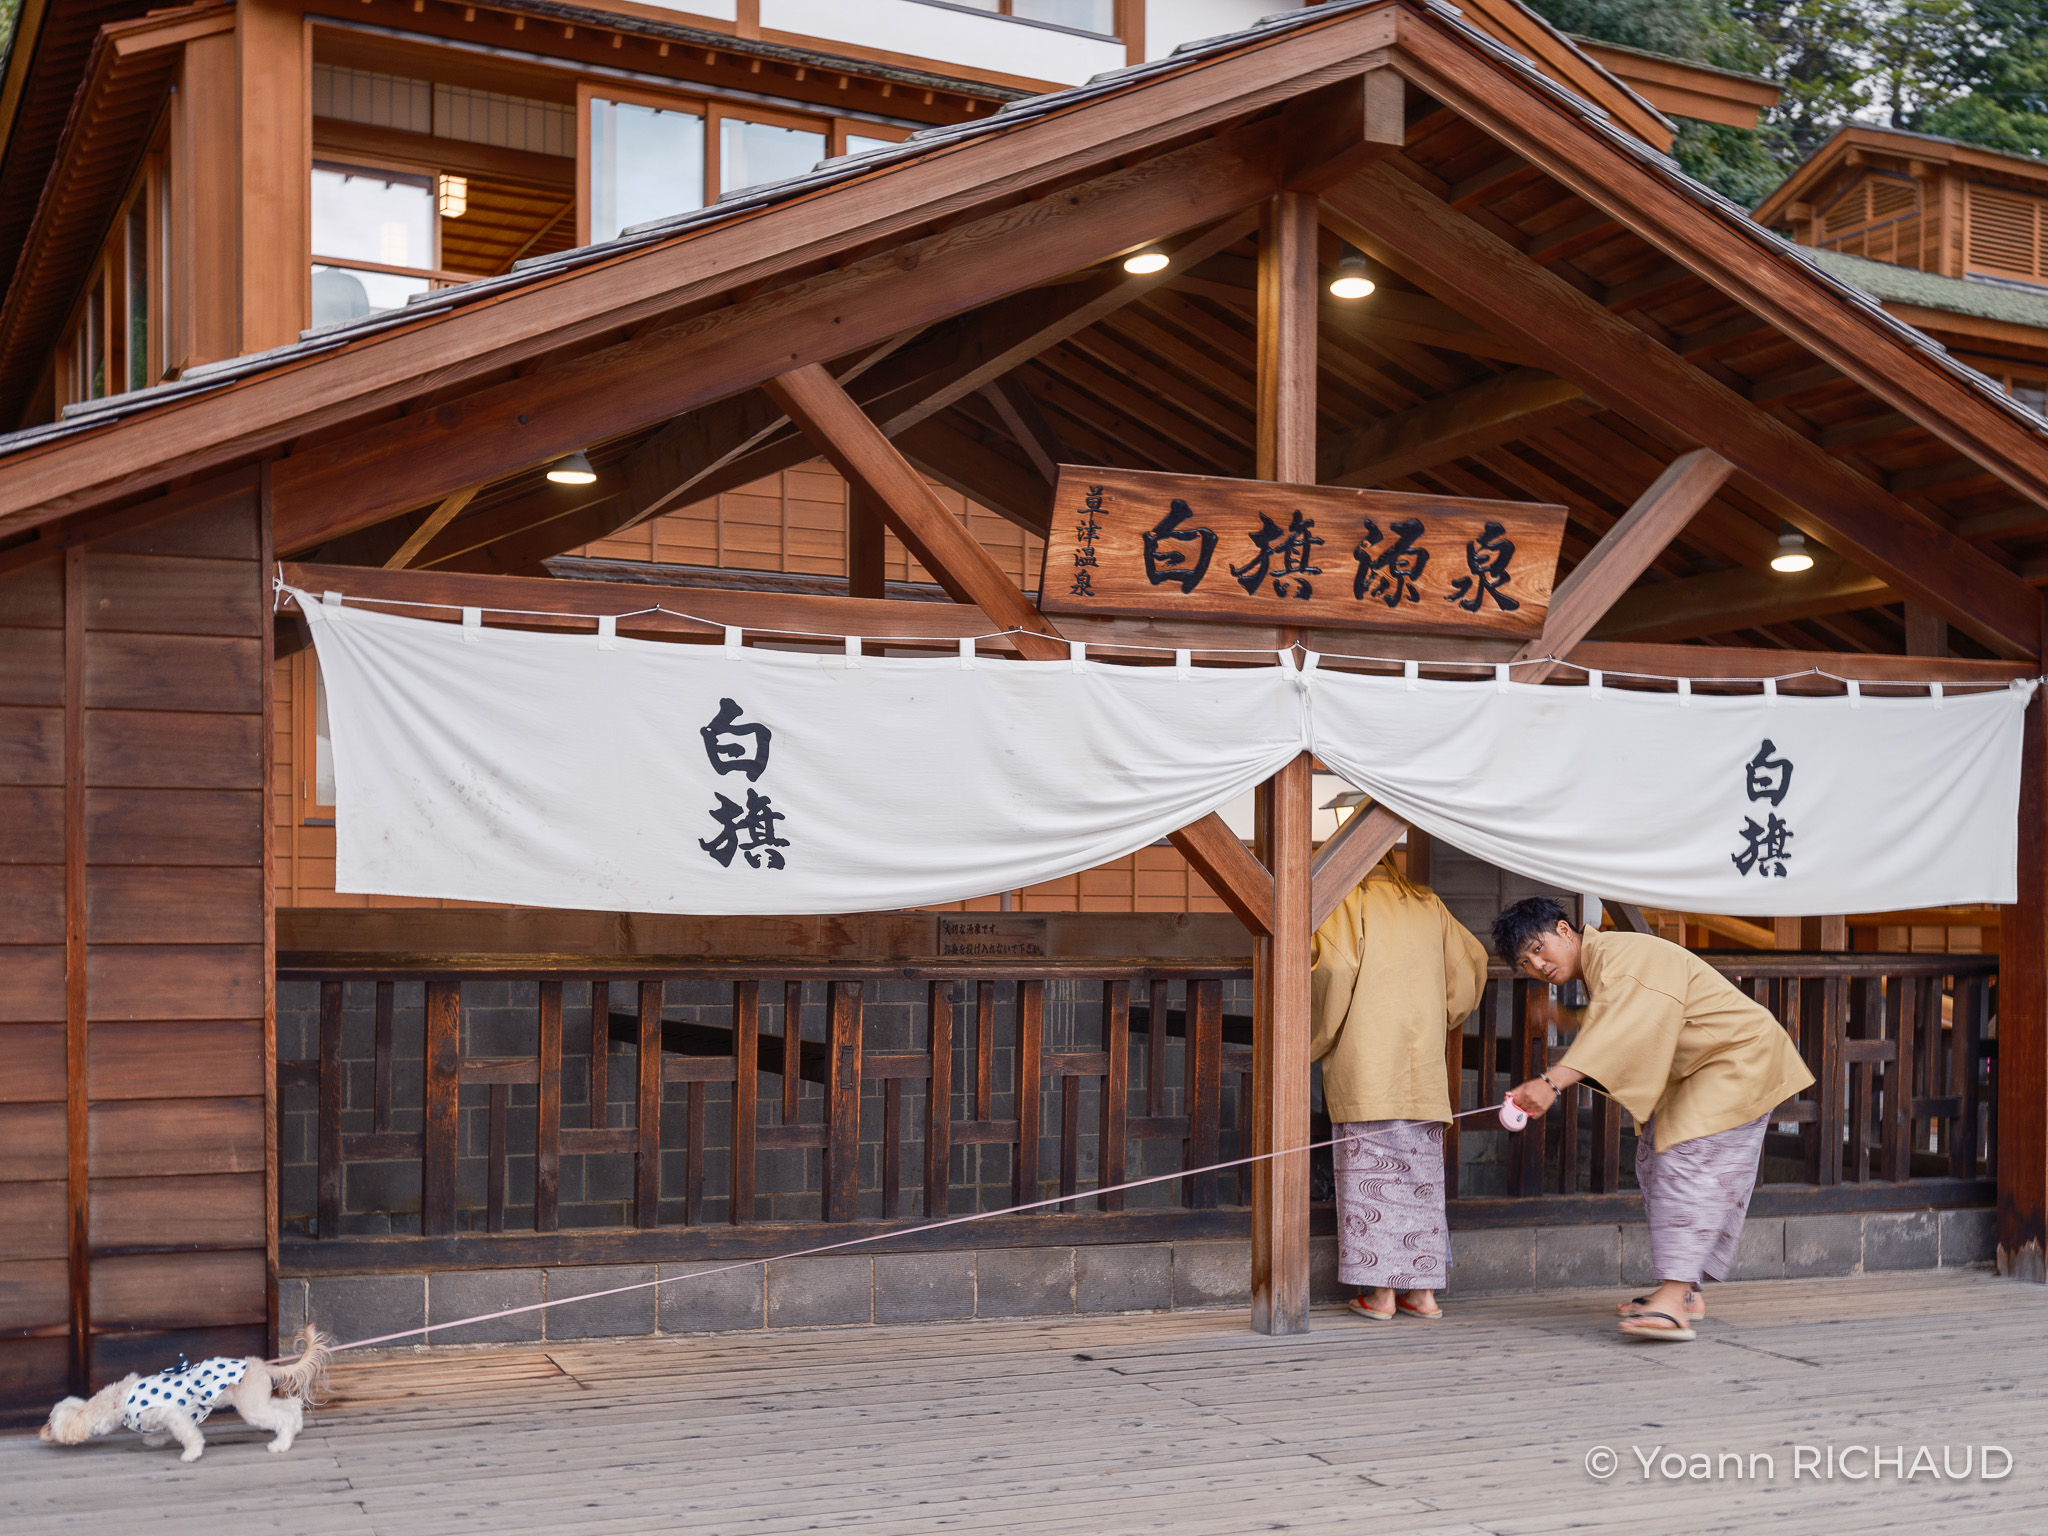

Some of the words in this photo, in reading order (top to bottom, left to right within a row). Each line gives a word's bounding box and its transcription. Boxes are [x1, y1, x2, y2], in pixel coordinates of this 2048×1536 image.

[1069, 485, 1110, 597] 草津温泉
[1142, 498, 1521, 613] 白旗源泉
[698, 697, 791, 871] 白旗
[1730, 738, 1795, 878] 白旗
